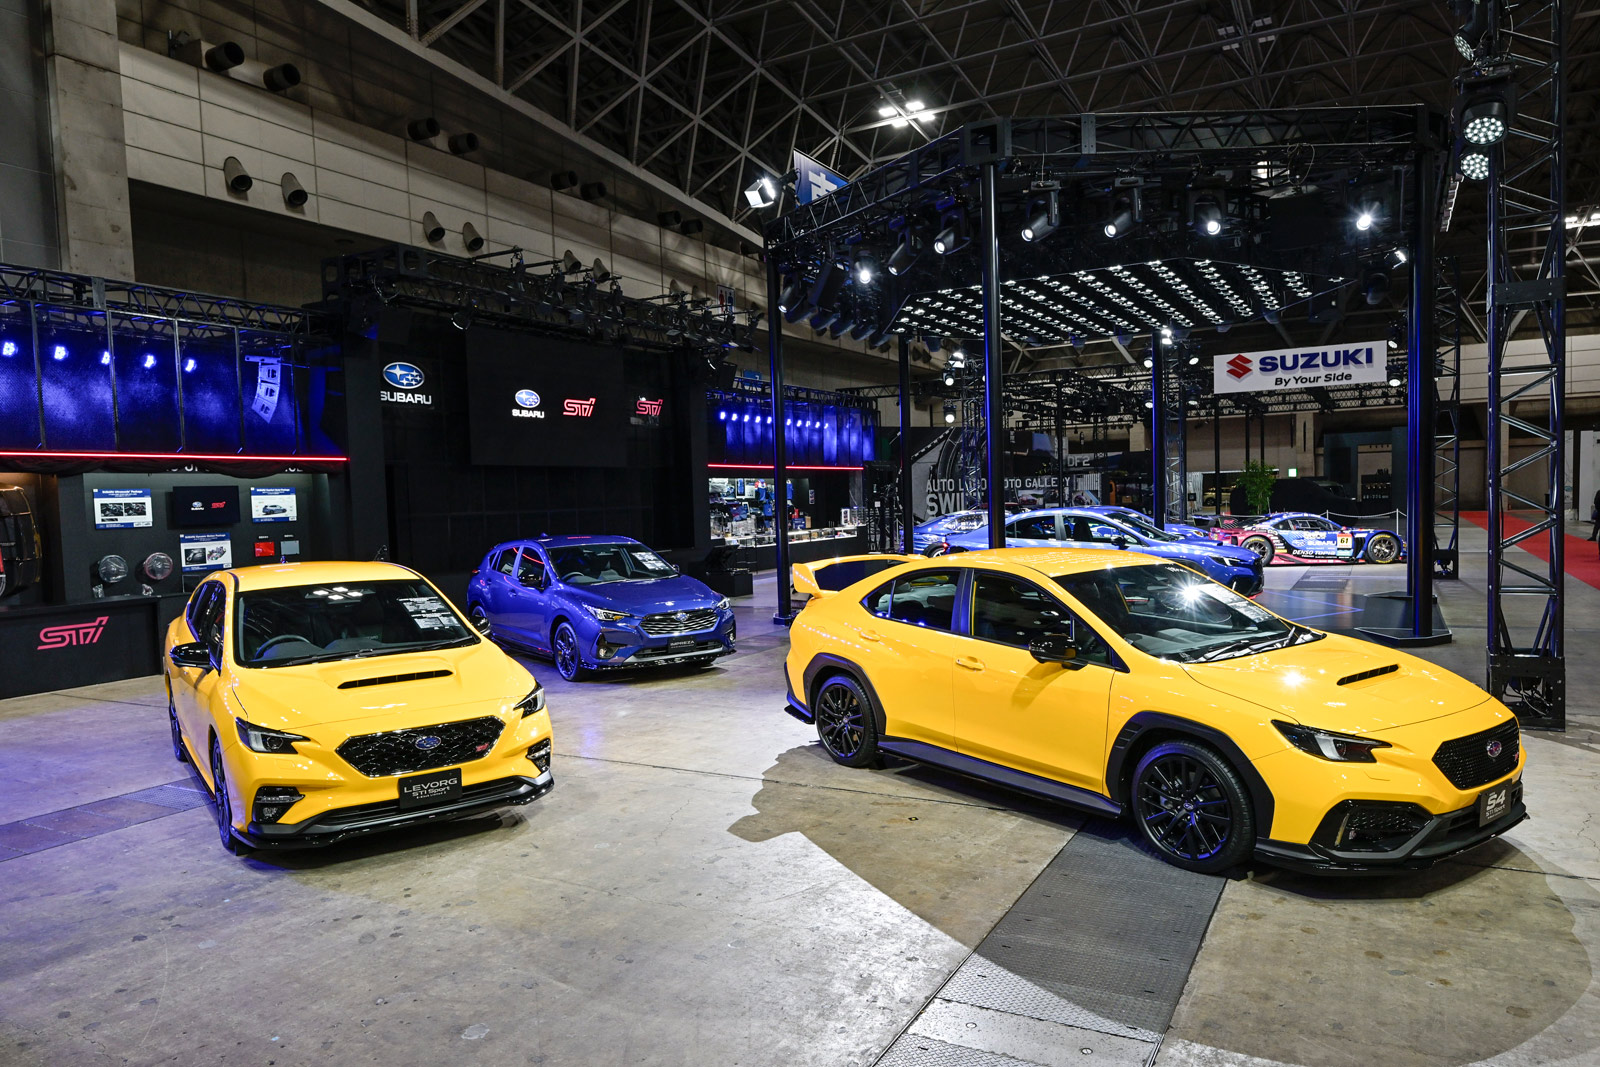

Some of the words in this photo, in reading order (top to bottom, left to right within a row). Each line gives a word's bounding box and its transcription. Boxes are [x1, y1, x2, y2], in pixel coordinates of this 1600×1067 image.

[1259, 347, 1373, 373] SUZUKI
[1275, 377, 1291, 387] By
[1294, 374, 1321, 384] Your
[1324, 372, 1353, 383] Side
[380, 390, 432, 405] SUBARU
[512, 408, 545, 419] SUBARU
[926, 478, 955, 492] AUTO
[1025, 476, 1071, 488] GALLEY
[404, 778, 457, 793] LEVORG
[428, 785, 450, 794] Sport
[1487, 790, 1505, 811] S4
